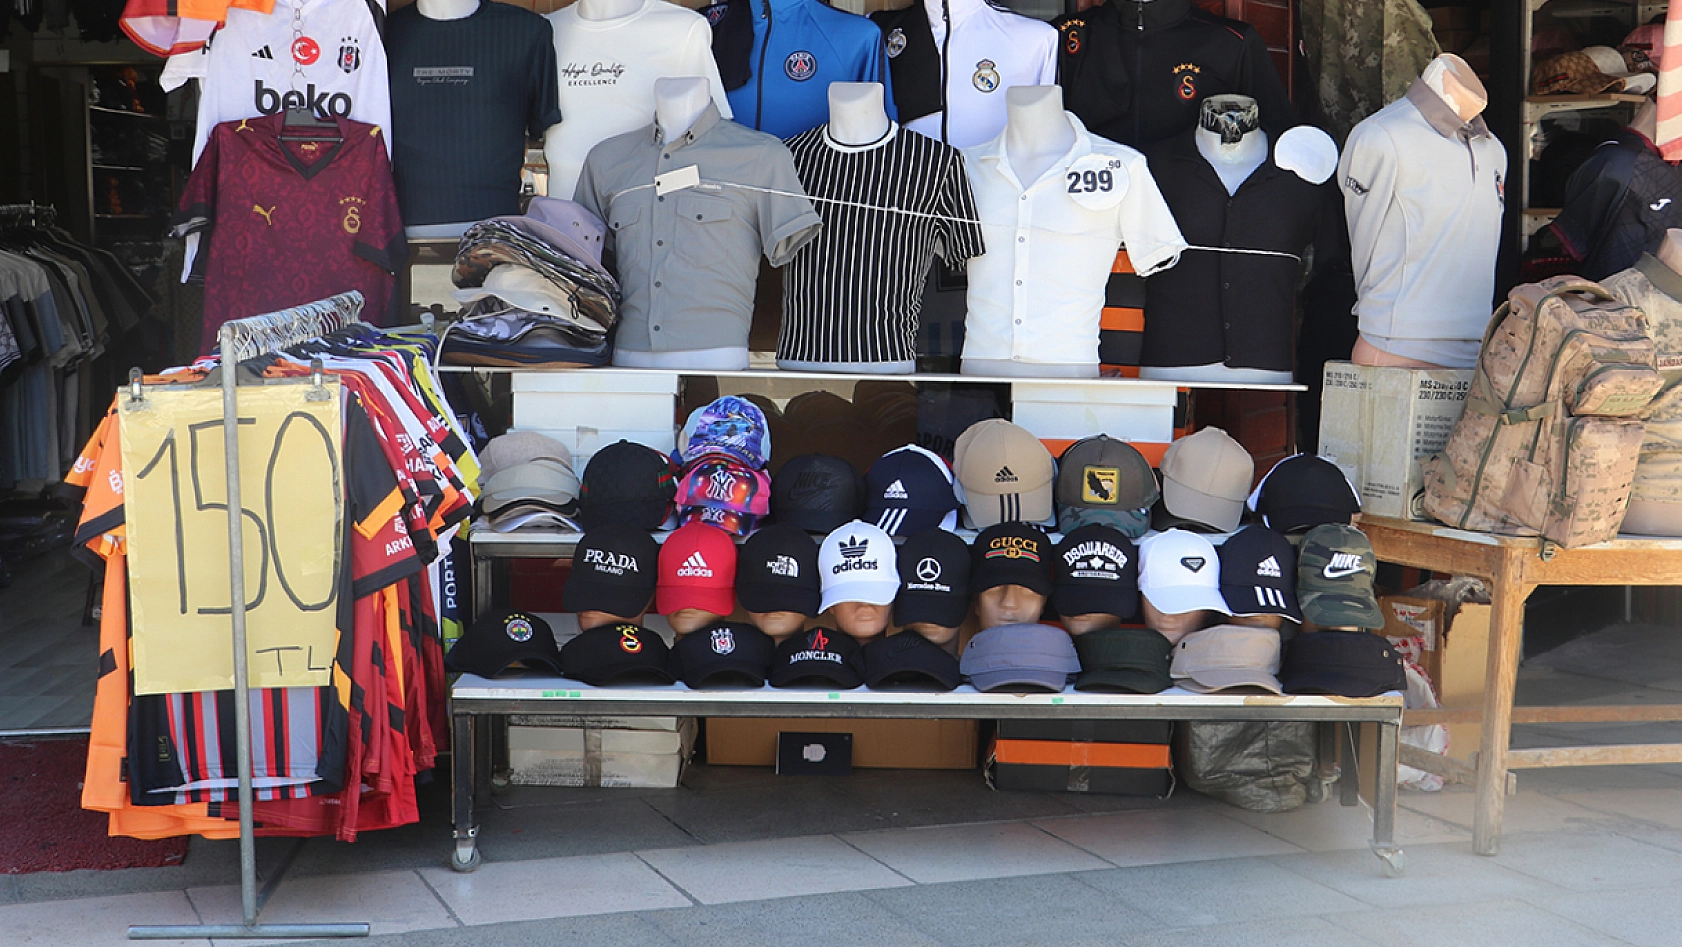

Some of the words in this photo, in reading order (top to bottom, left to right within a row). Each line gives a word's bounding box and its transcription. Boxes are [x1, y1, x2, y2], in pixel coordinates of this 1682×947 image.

[562, 62, 588, 79] High
[591, 61, 625, 78] Quality
[568, 79, 617, 87] EXCELLENCE
[254, 79, 352, 119] beko
[1066, 169, 1113, 193] 299
[994, 475, 1019, 483] adidas
[137, 411, 342, 615] 150
[989, 536, 1039, 553] GUCCI
[583, 548, 639, 573] PRADA
[832, 558, 878, 575] adidas
[1329, 552, 1363, 570] NIKE
[594, 563, 625, 576] MILANO
[676, 565, 714, 578] adidas
[256, 645, 327, 677] TL
[789, 651, 844, 665] MONCLER
